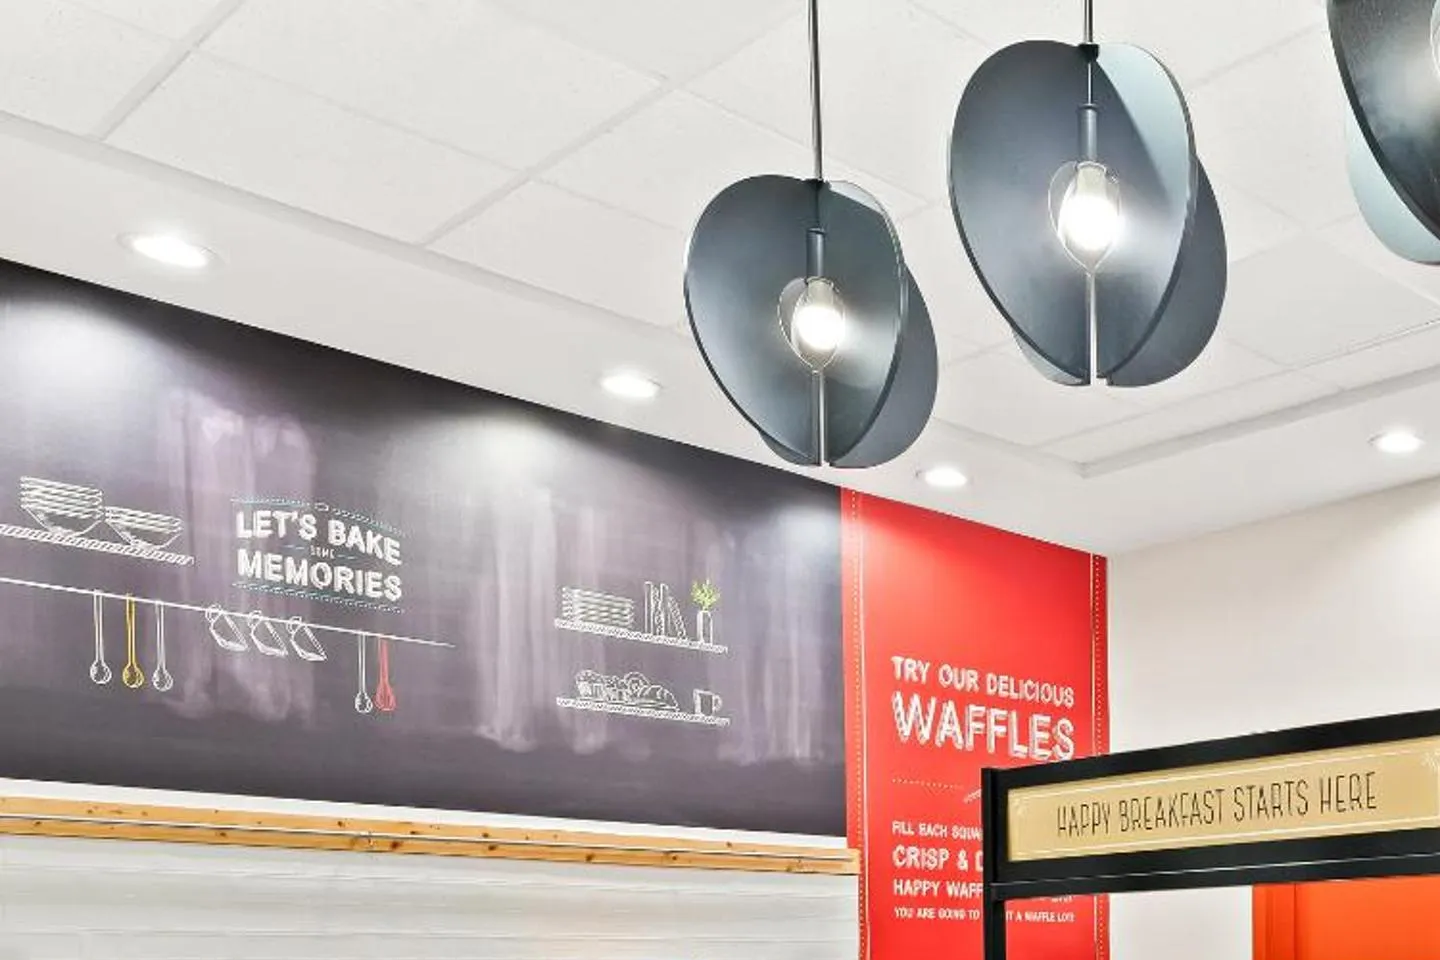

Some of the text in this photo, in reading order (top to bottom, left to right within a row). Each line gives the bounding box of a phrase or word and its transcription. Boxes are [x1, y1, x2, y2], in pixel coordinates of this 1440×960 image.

[236, 510, 402, 566] LET'S BAKE
[237, 548, 402, 601] MEMORIES
[891, 655, 1074, 708] TRY OUR DELICIOUS
[892, 691, 1075, 761] WAFFLES
[892, 821, 915, 836] FILL
[919, 823, 948, 838] EACH
[1057, 771, 1377, 837] HAPPY BREAKFAST STARTS HERE
[892, 844, 950, 870] CRISP
[957, 849, 968, 872] &
[893, 879, 940, 897] HAPPY
[968, 909, 980, 920] TO
